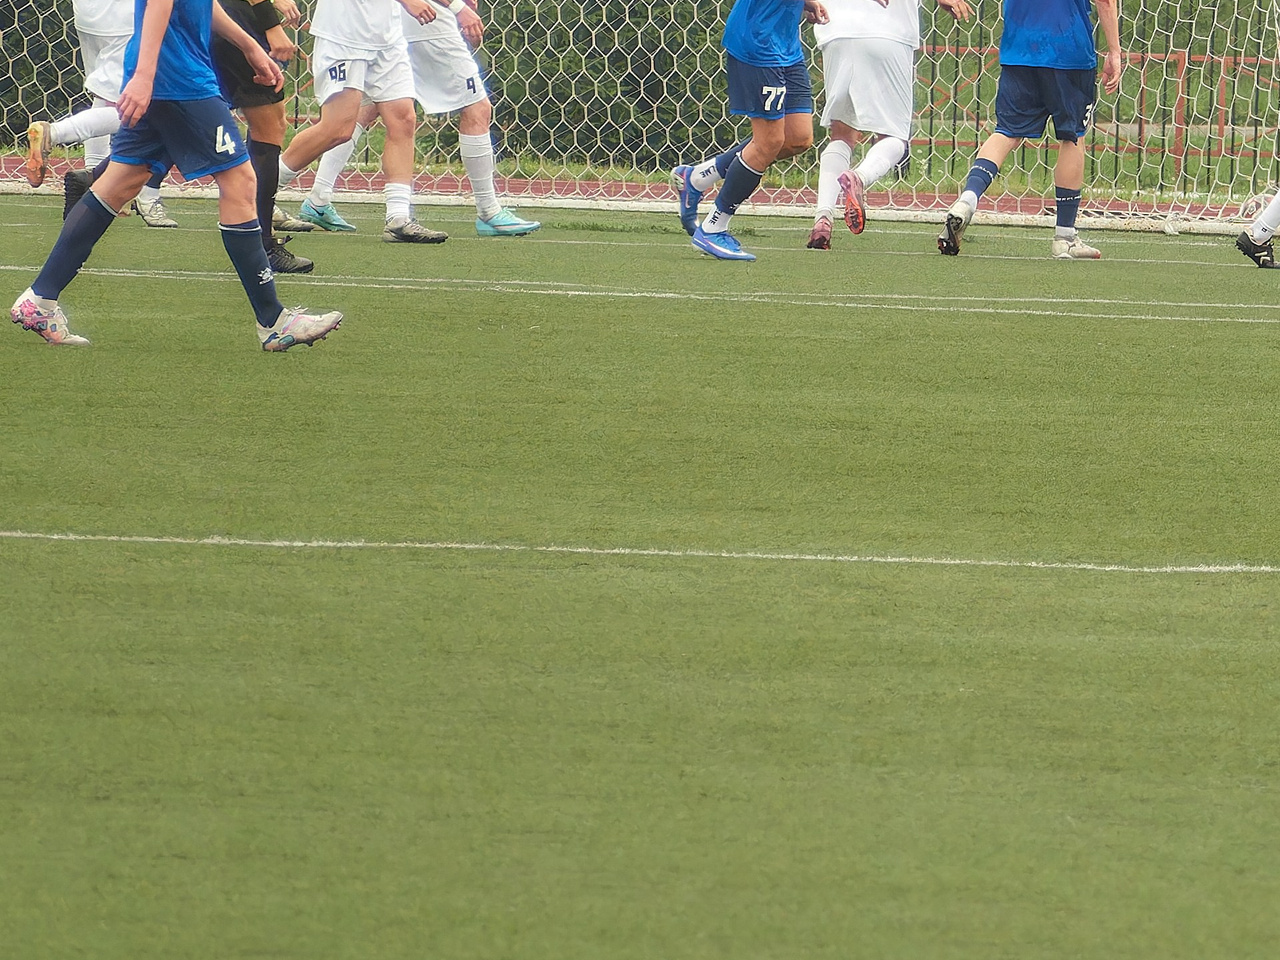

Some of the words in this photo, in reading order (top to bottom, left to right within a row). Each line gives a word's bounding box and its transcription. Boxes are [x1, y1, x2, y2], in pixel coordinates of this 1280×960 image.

[329, 62, 346, 83] 96
[762, 86, 786, 111] 77
[215, 125, 236, 155] 4
